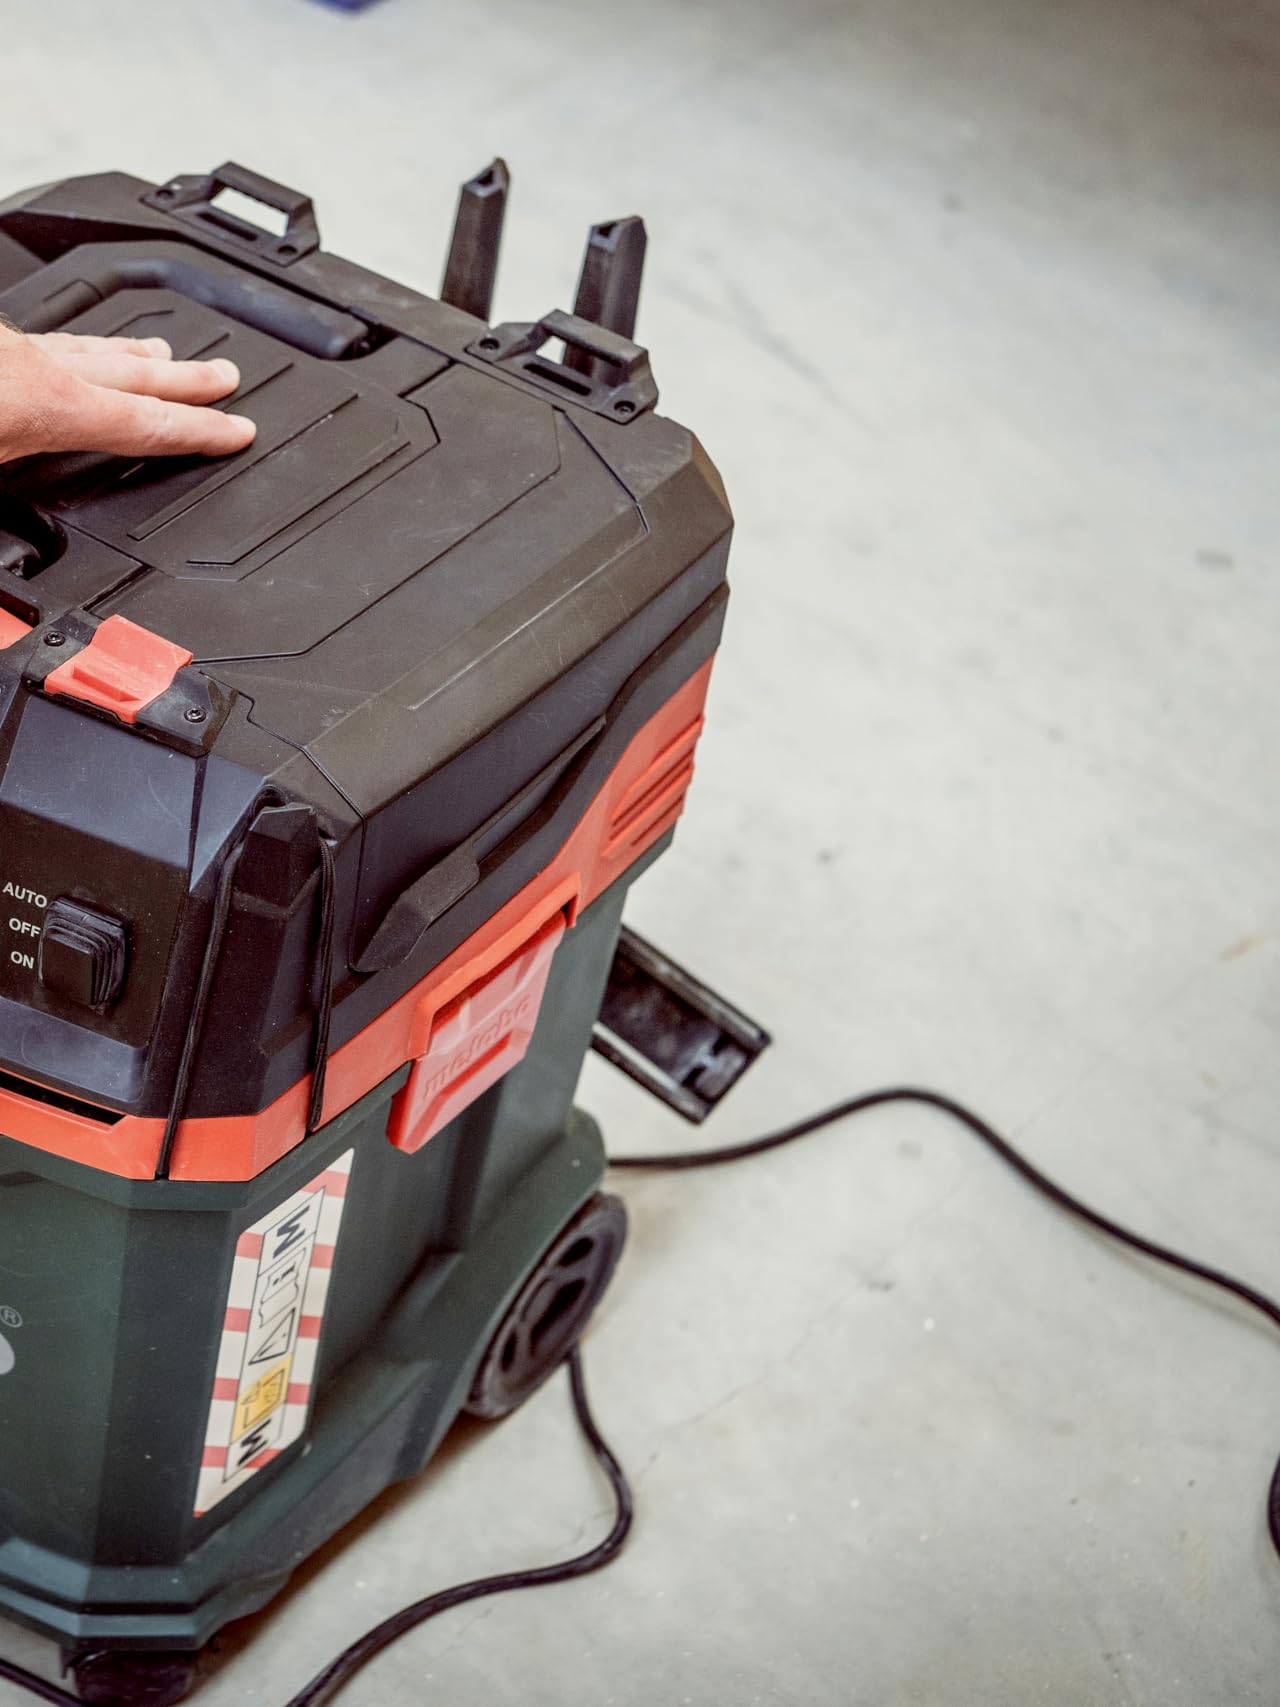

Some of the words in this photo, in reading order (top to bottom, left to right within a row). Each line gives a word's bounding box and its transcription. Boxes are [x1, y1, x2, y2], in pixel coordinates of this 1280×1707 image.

[2, 882, 48, 908] AUTO
[8, 917, 41, 938] OFF
[10, 951, 35, 969] ON
